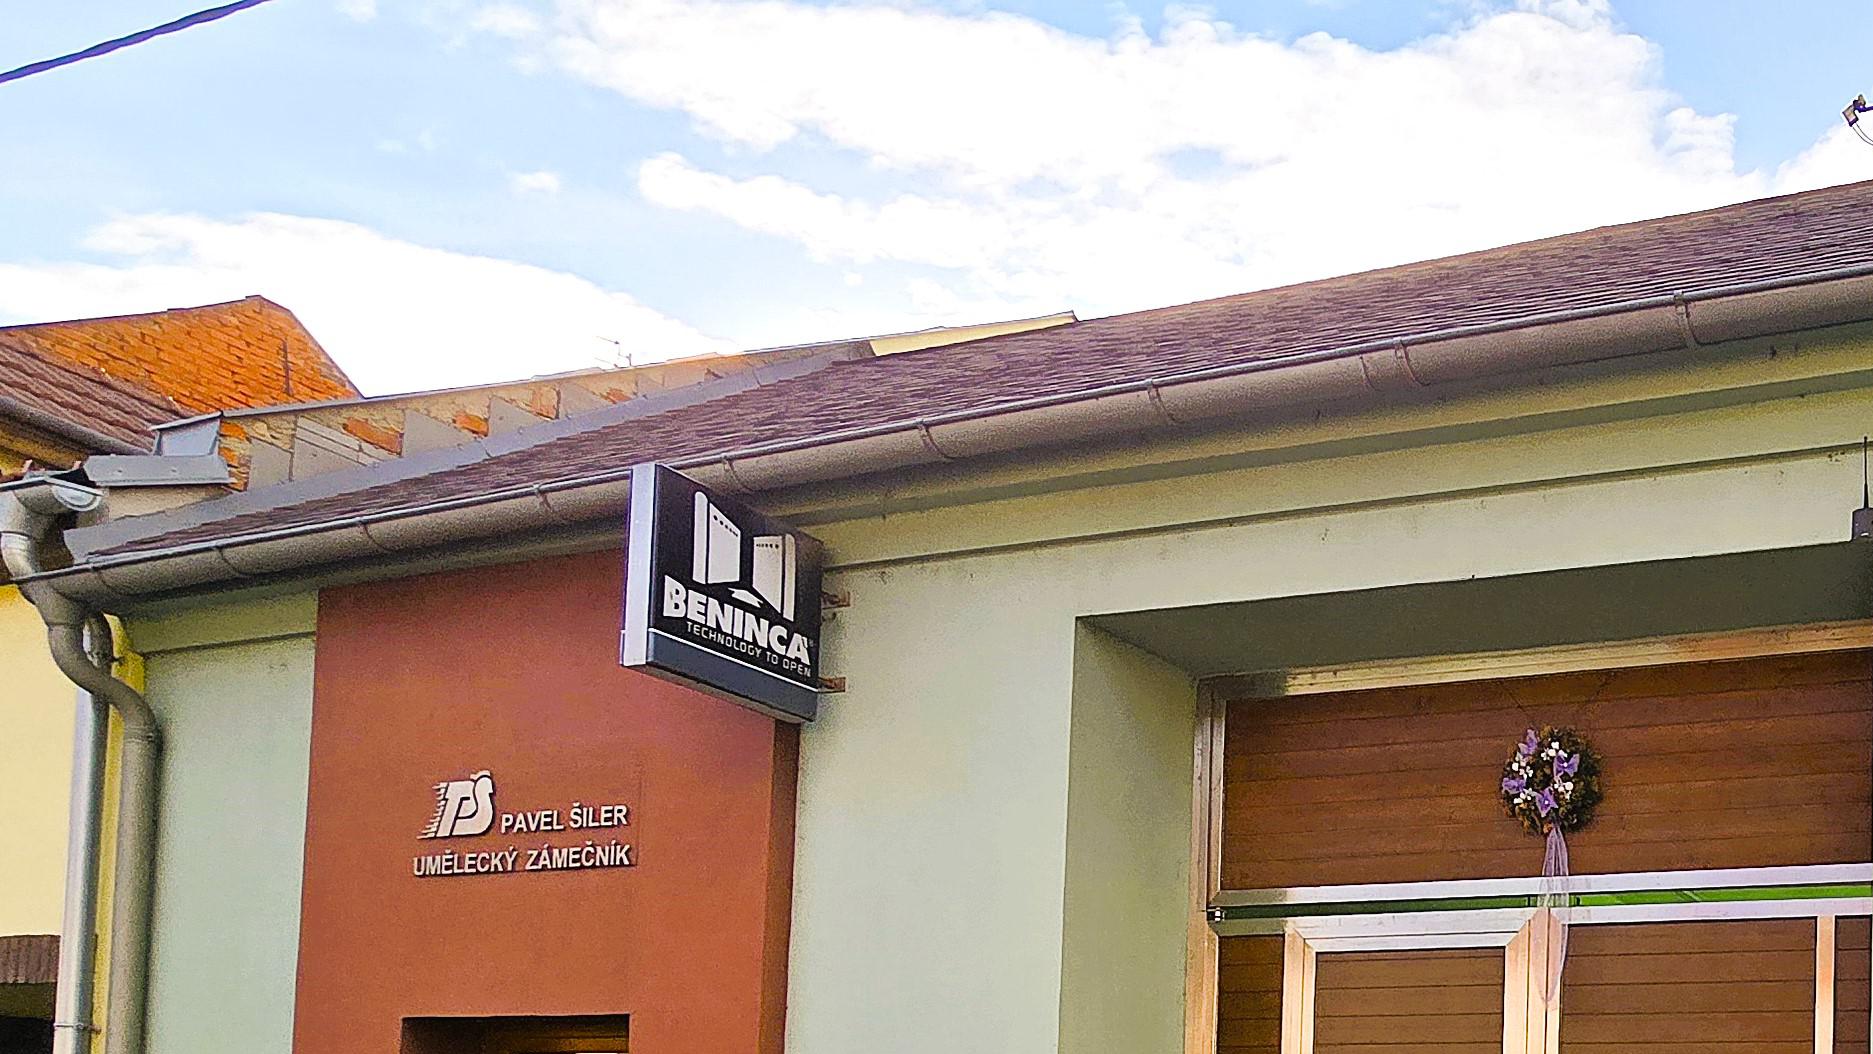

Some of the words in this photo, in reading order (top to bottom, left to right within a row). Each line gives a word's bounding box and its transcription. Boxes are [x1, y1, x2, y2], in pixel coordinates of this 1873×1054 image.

[686, 621, 762, 658] TECHNOLOGY
[766, 651, 779, 665] TO
[782, 658, 811, 678] OPEN
[501, 811, 564, 834] PAVEL
[569, 801, 628, 829] ŠILER
[413, 846, 518, 876] UMĚLECKÝ
[525, 840, 630, 870] ZÁMEČNÍK
